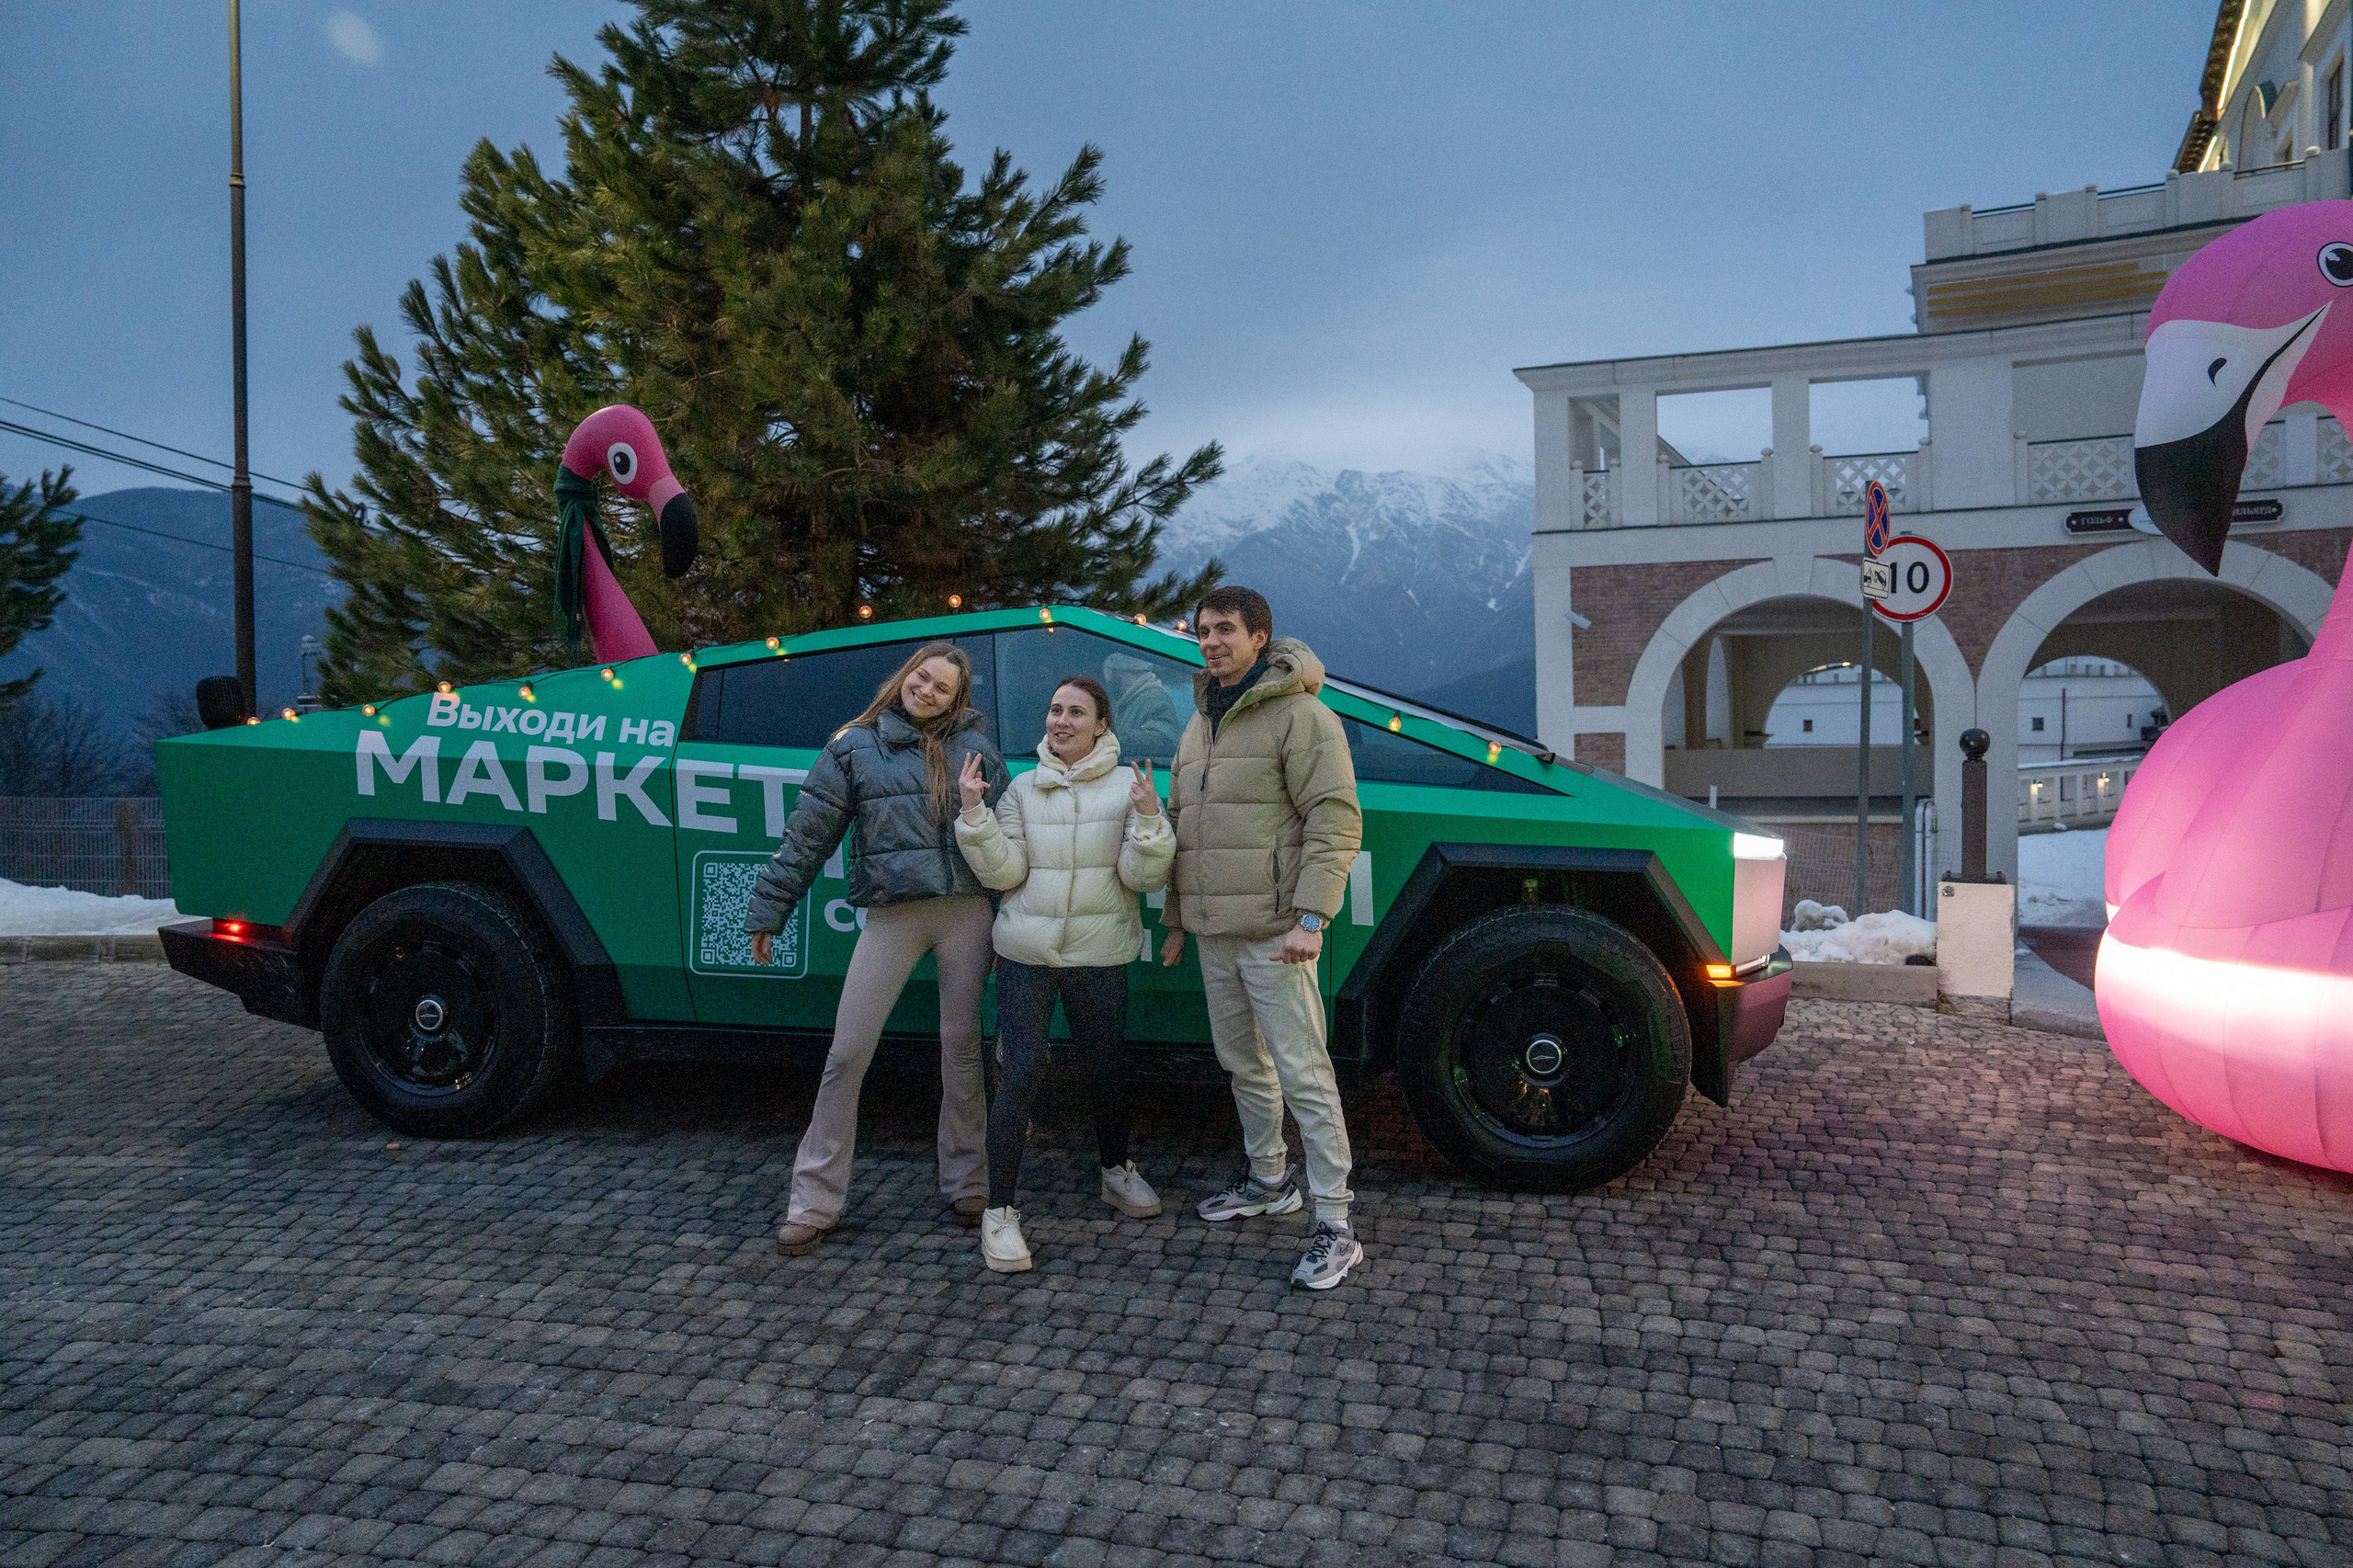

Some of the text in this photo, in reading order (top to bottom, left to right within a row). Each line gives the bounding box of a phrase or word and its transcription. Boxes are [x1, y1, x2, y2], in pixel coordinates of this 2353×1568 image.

[2080, 516, 2114, 526] ГОЛЬФ
[1889, 561, 1930, 595] 10
[426, 691, 676, 747] Выходи на
[355, 729, 811, 839] МАРКЕТ
